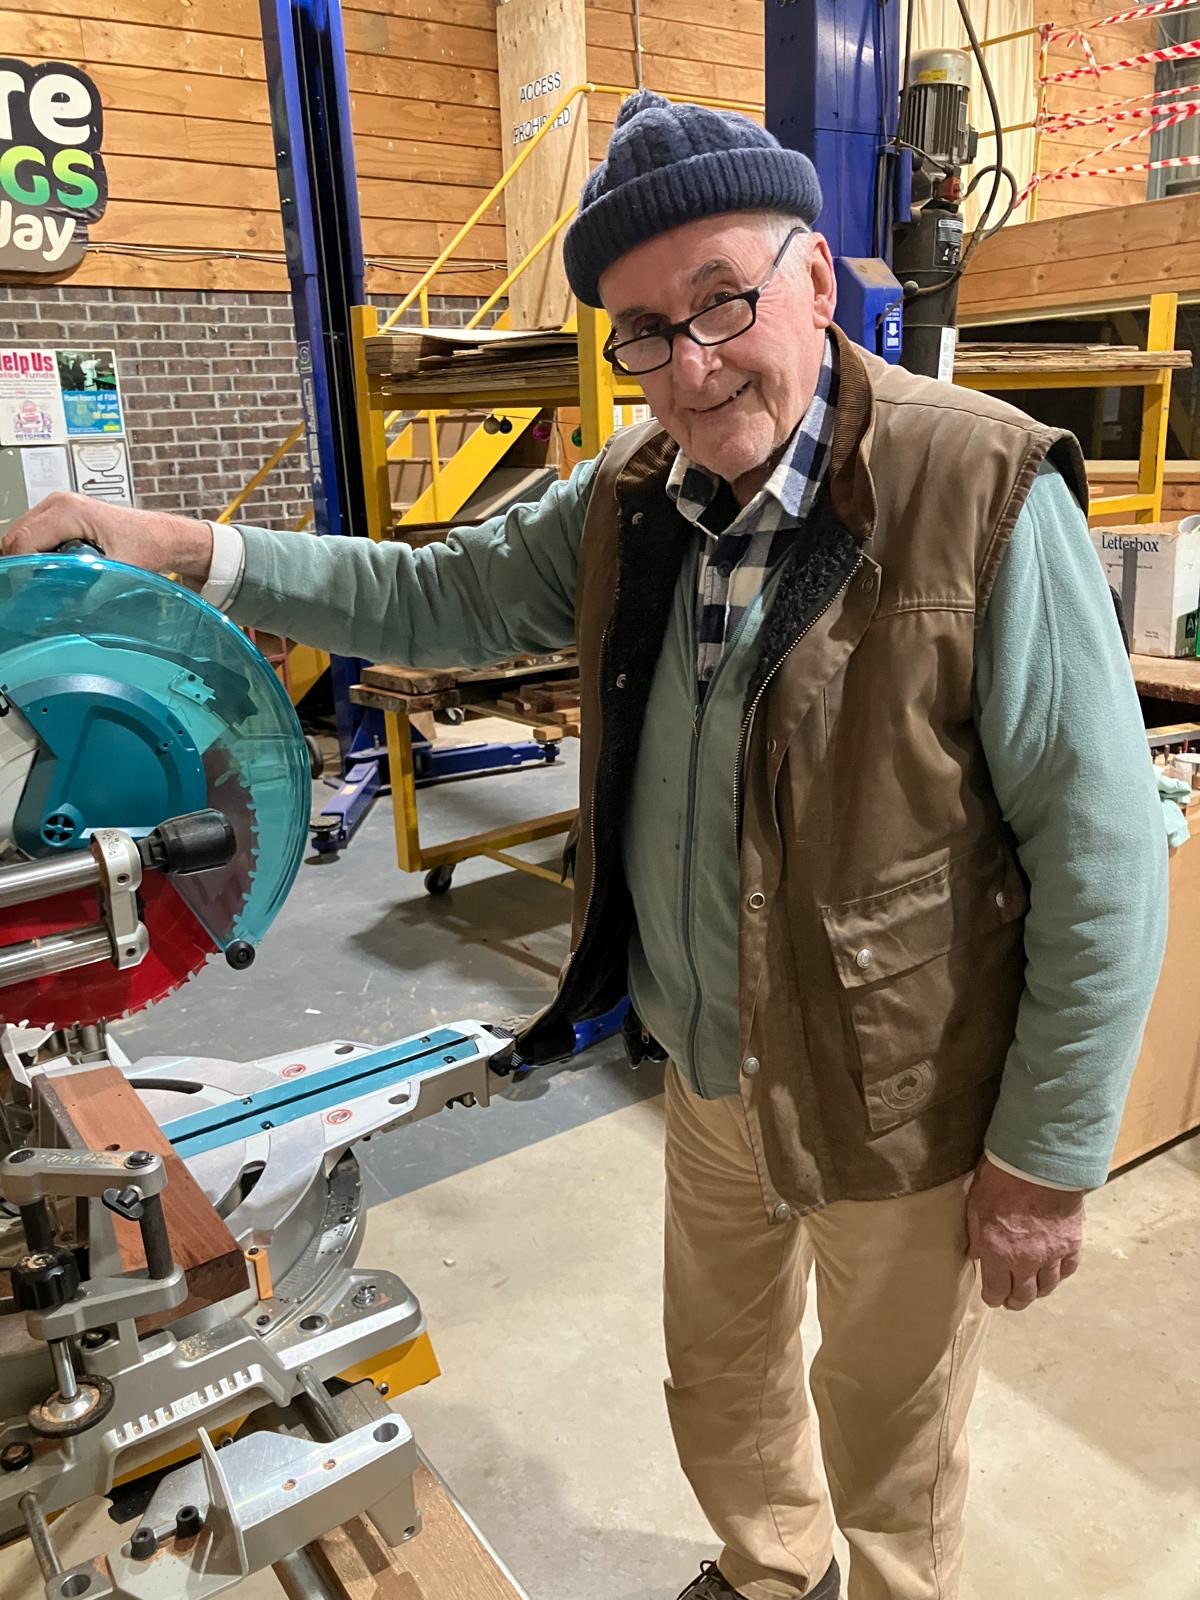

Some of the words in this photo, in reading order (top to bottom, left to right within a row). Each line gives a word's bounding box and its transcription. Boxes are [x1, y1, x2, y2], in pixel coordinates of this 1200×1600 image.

[520, 71, 561, 104] ACCESS
[0, 70, 92, 145] re
[513, 107, 571, 143] PROHIED
[0, 145, 98, 209] GS
[0, 352, 30, 374] elp
[31, 352, 54, 371] Us
[1102, 535, 1159, 552] Letterbox
